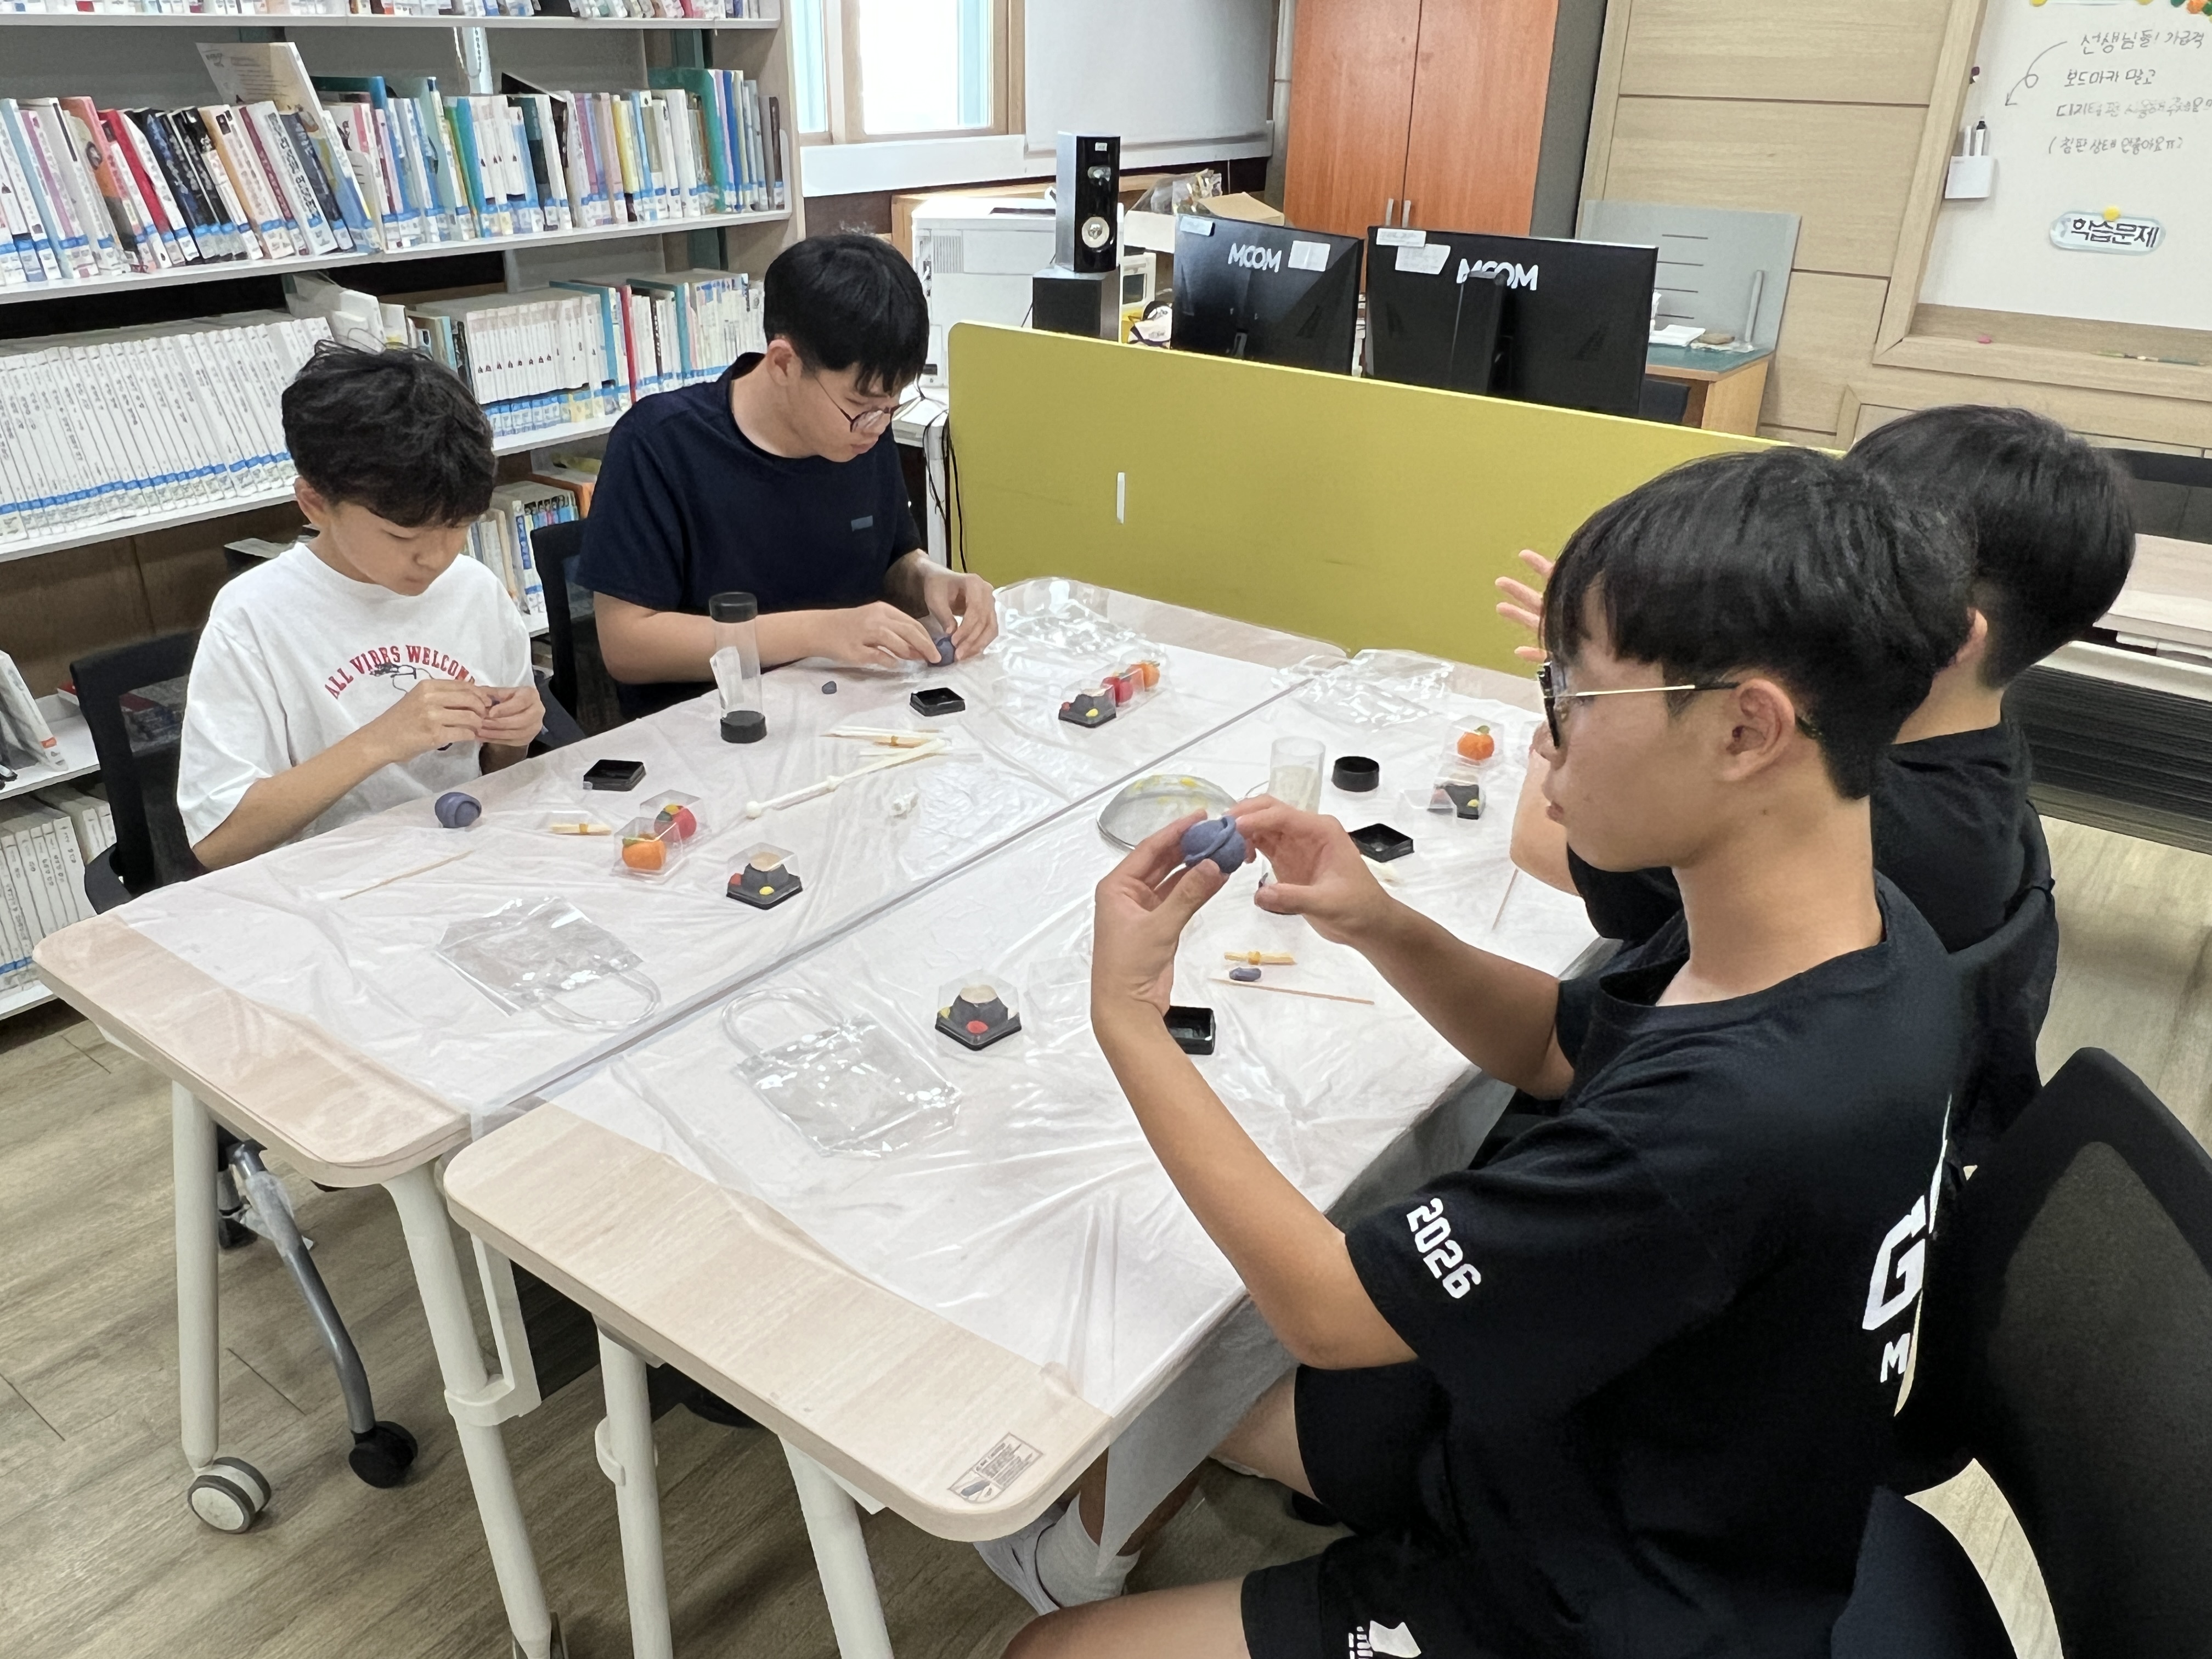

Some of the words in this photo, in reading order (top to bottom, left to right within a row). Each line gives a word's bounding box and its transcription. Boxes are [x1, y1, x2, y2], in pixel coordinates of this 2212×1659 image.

[2064, 69, 2119, 87] 보드마카
[2070, 218, 2160, 249] 학습문제
[1227, 242, 1283, 273] MCOM
[324, 667, 354, 700] ALL
[1406, 1197, 1482, 1299] 2026
